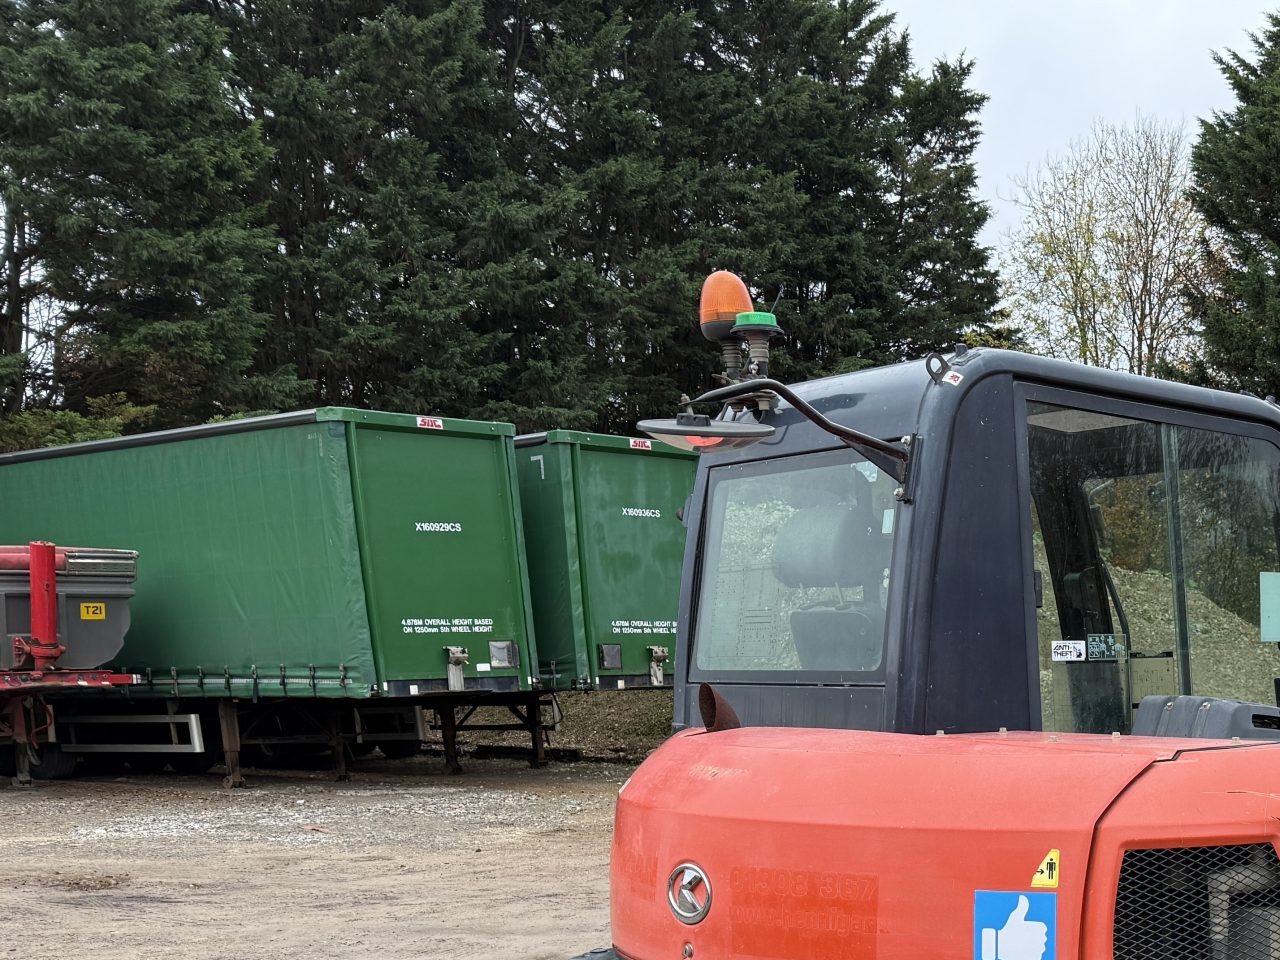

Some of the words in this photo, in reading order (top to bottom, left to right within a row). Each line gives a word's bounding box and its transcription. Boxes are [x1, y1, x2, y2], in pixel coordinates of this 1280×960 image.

[415, 522, 462, 532] X160929CS
[84, 605, 102, 615] T21
[424, 618, 451, 626] OVERALL
[451, 618, 473, 626] HEIGHT
[474, 618, 493, 626] BASED
[403, 626, 413, 634] ON
[472, 625, 493, 633] HEIGHT
